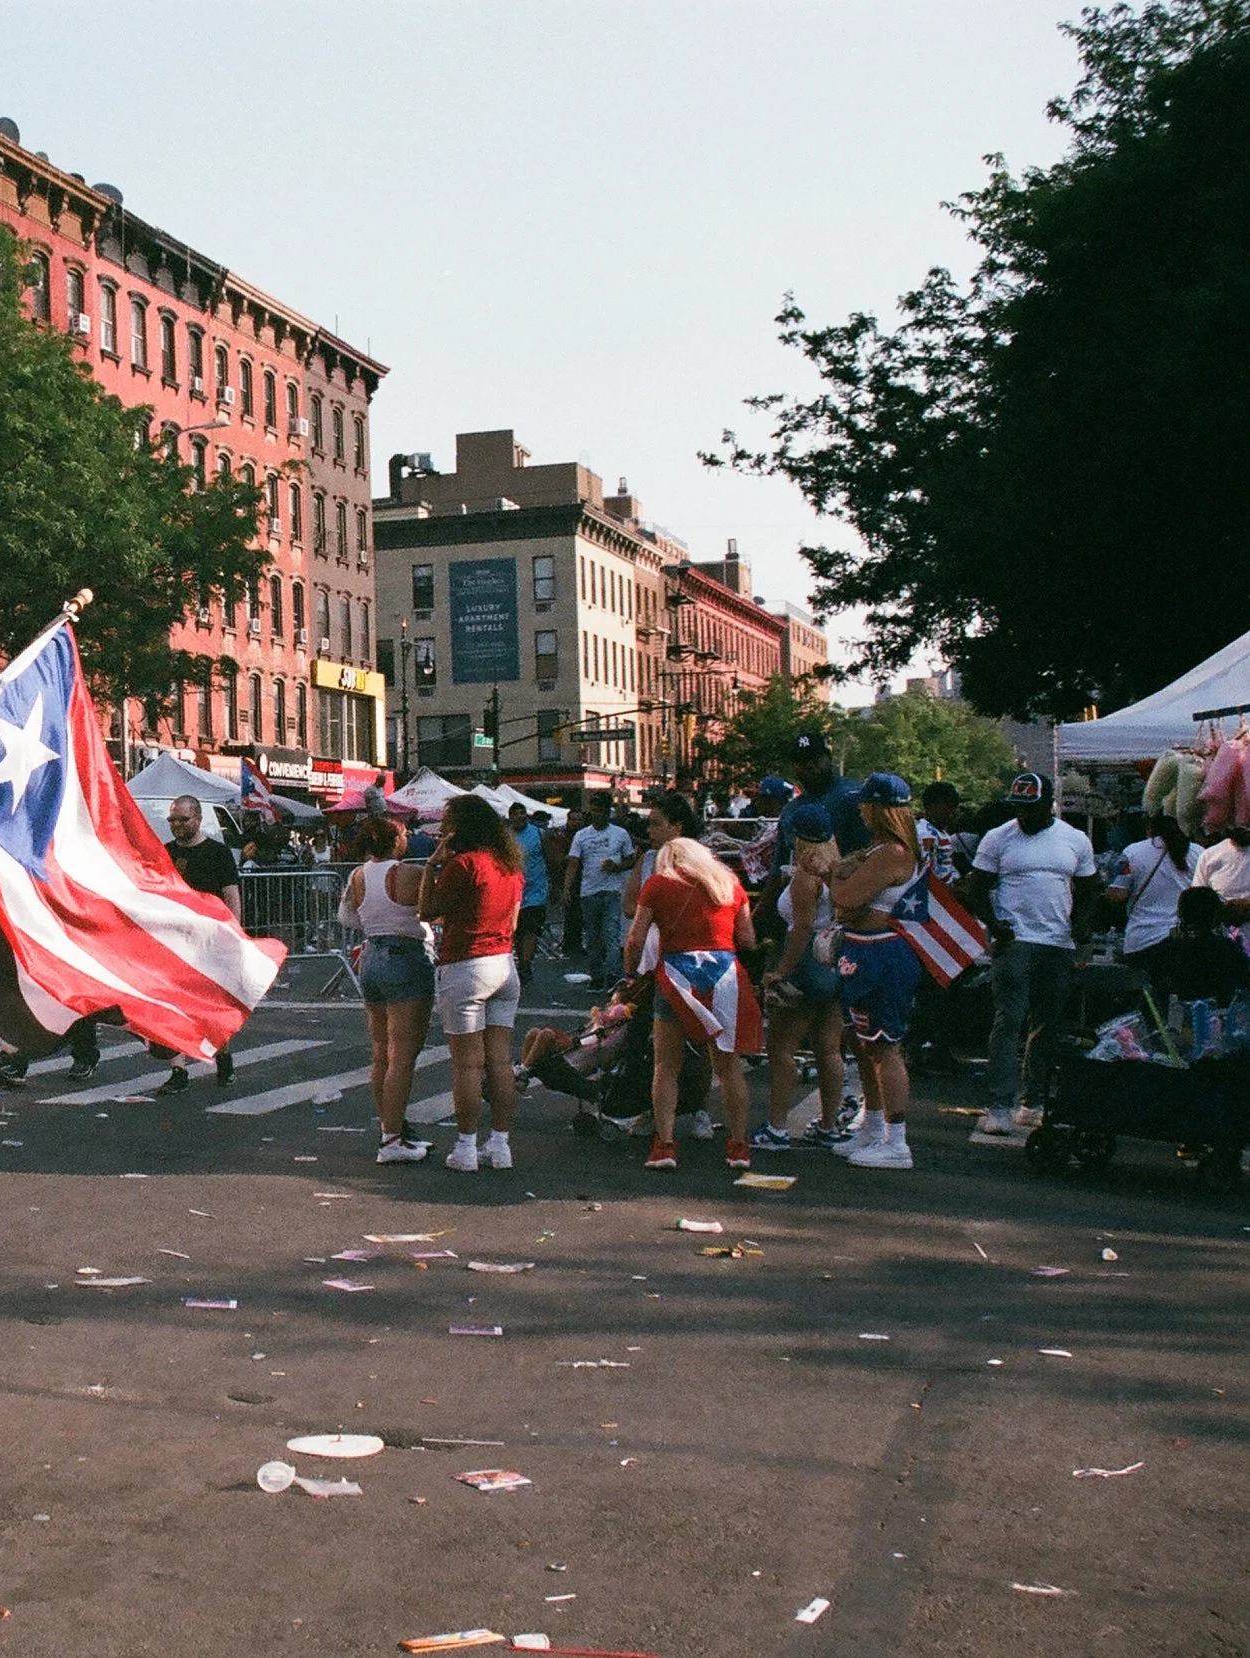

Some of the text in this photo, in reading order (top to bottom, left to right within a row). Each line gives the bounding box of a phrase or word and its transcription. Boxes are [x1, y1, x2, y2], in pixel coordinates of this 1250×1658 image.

[466, 603, 502, 613] LUXURY
[458, 612, 511, 624] APARTMENT
[465, 624, 504, 633] RENTALS
